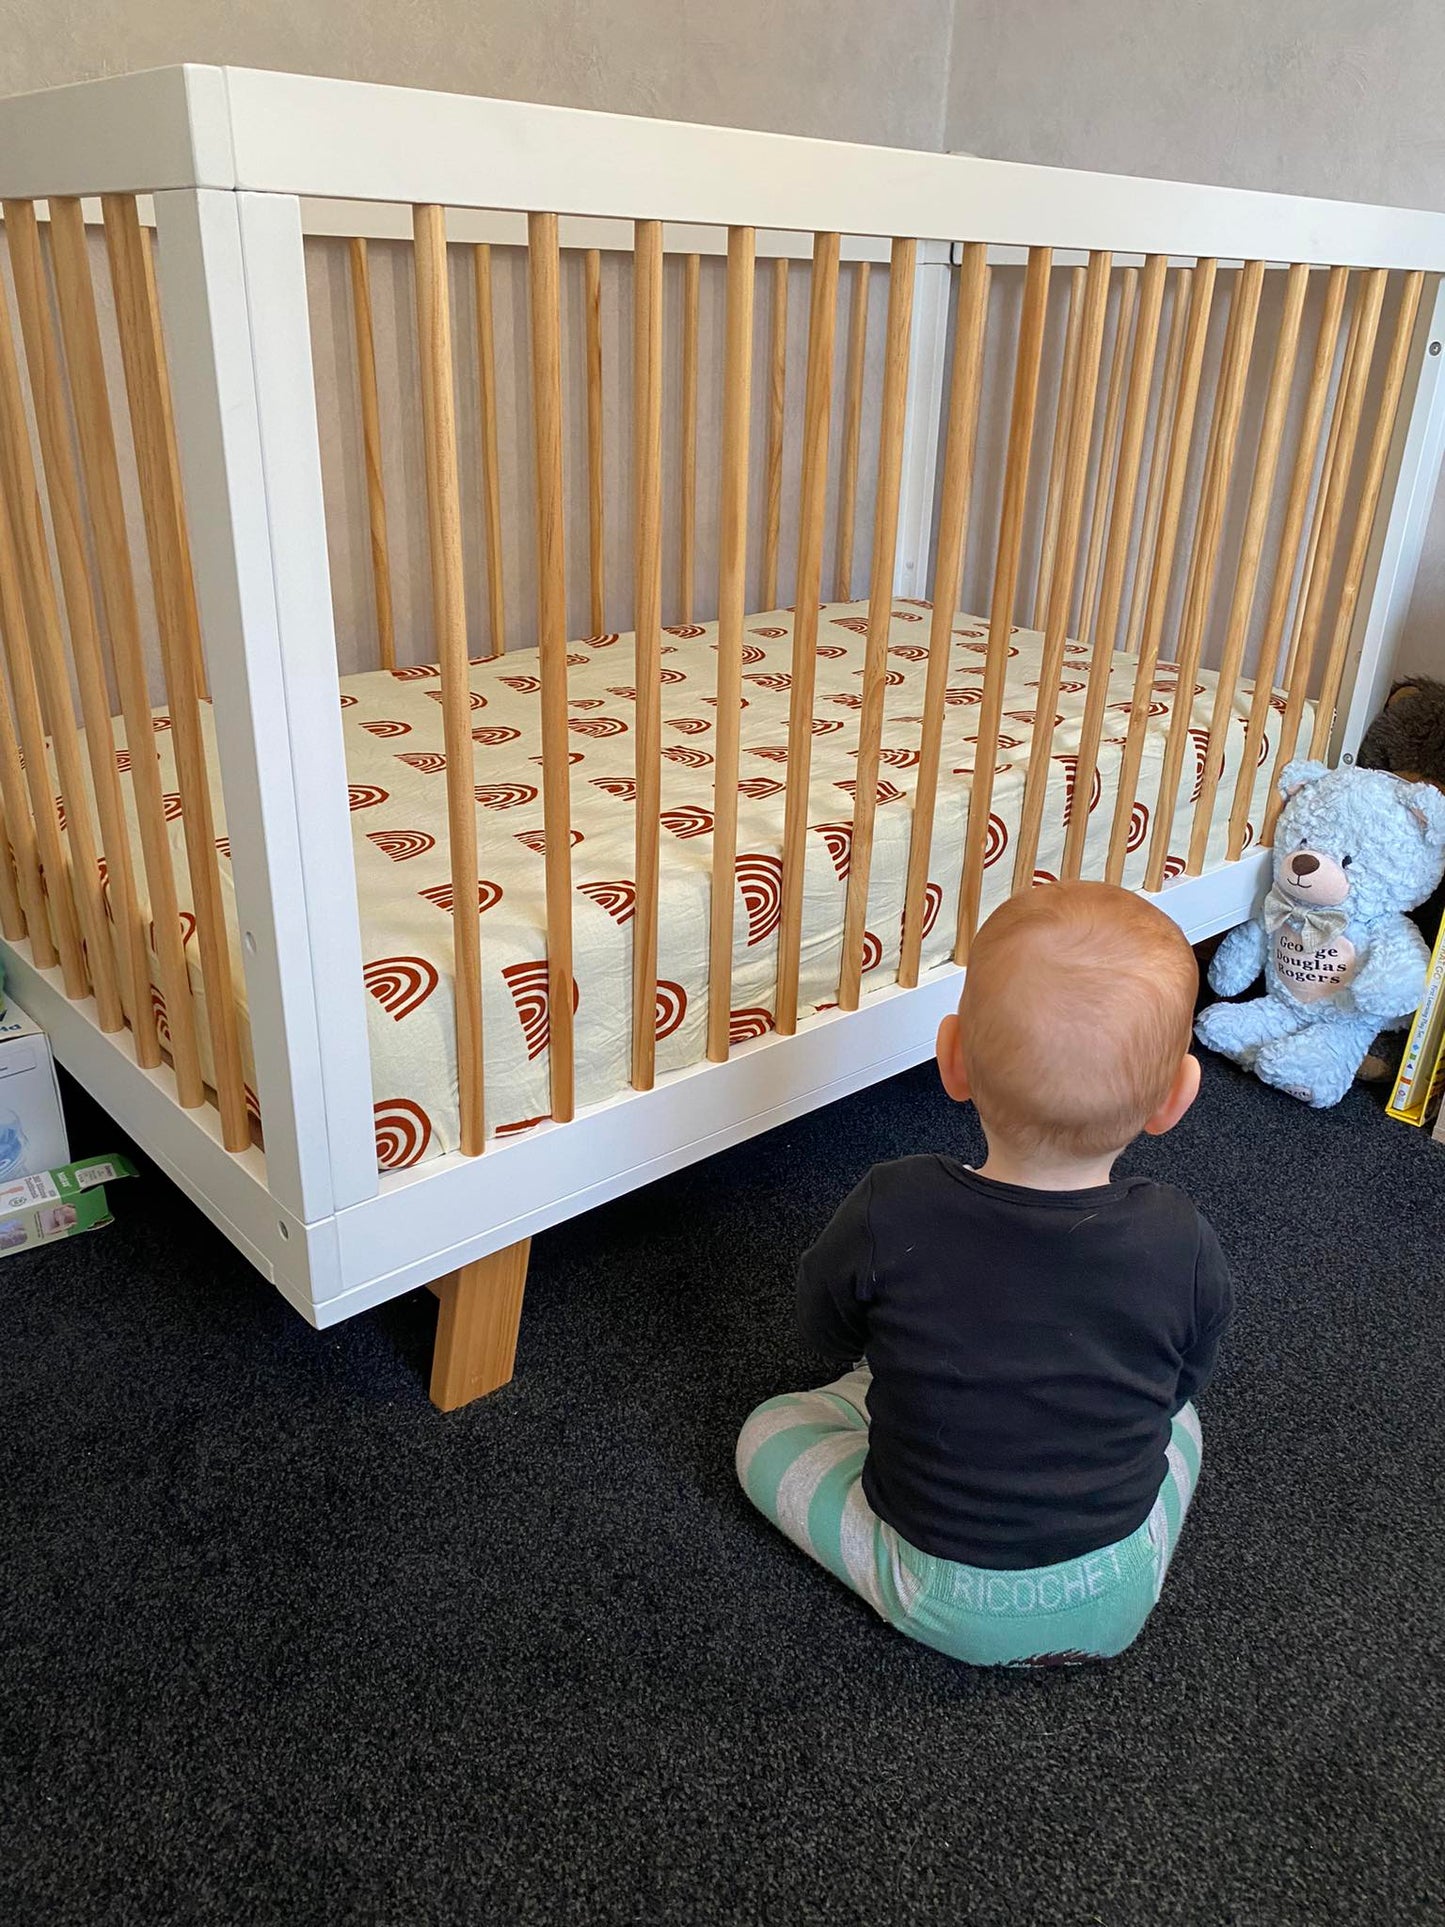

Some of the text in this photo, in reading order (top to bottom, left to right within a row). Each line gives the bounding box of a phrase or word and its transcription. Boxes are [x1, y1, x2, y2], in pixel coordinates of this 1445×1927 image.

[1279, 936, 1338, 960] Geoge
[1276, 949, 1347, 972] Douglas
[1278, 963, 1341, 984] Rogers
[1434, 966, 1443, 980] GO
[953, 1546, 1120, 1612] RICOCHET
